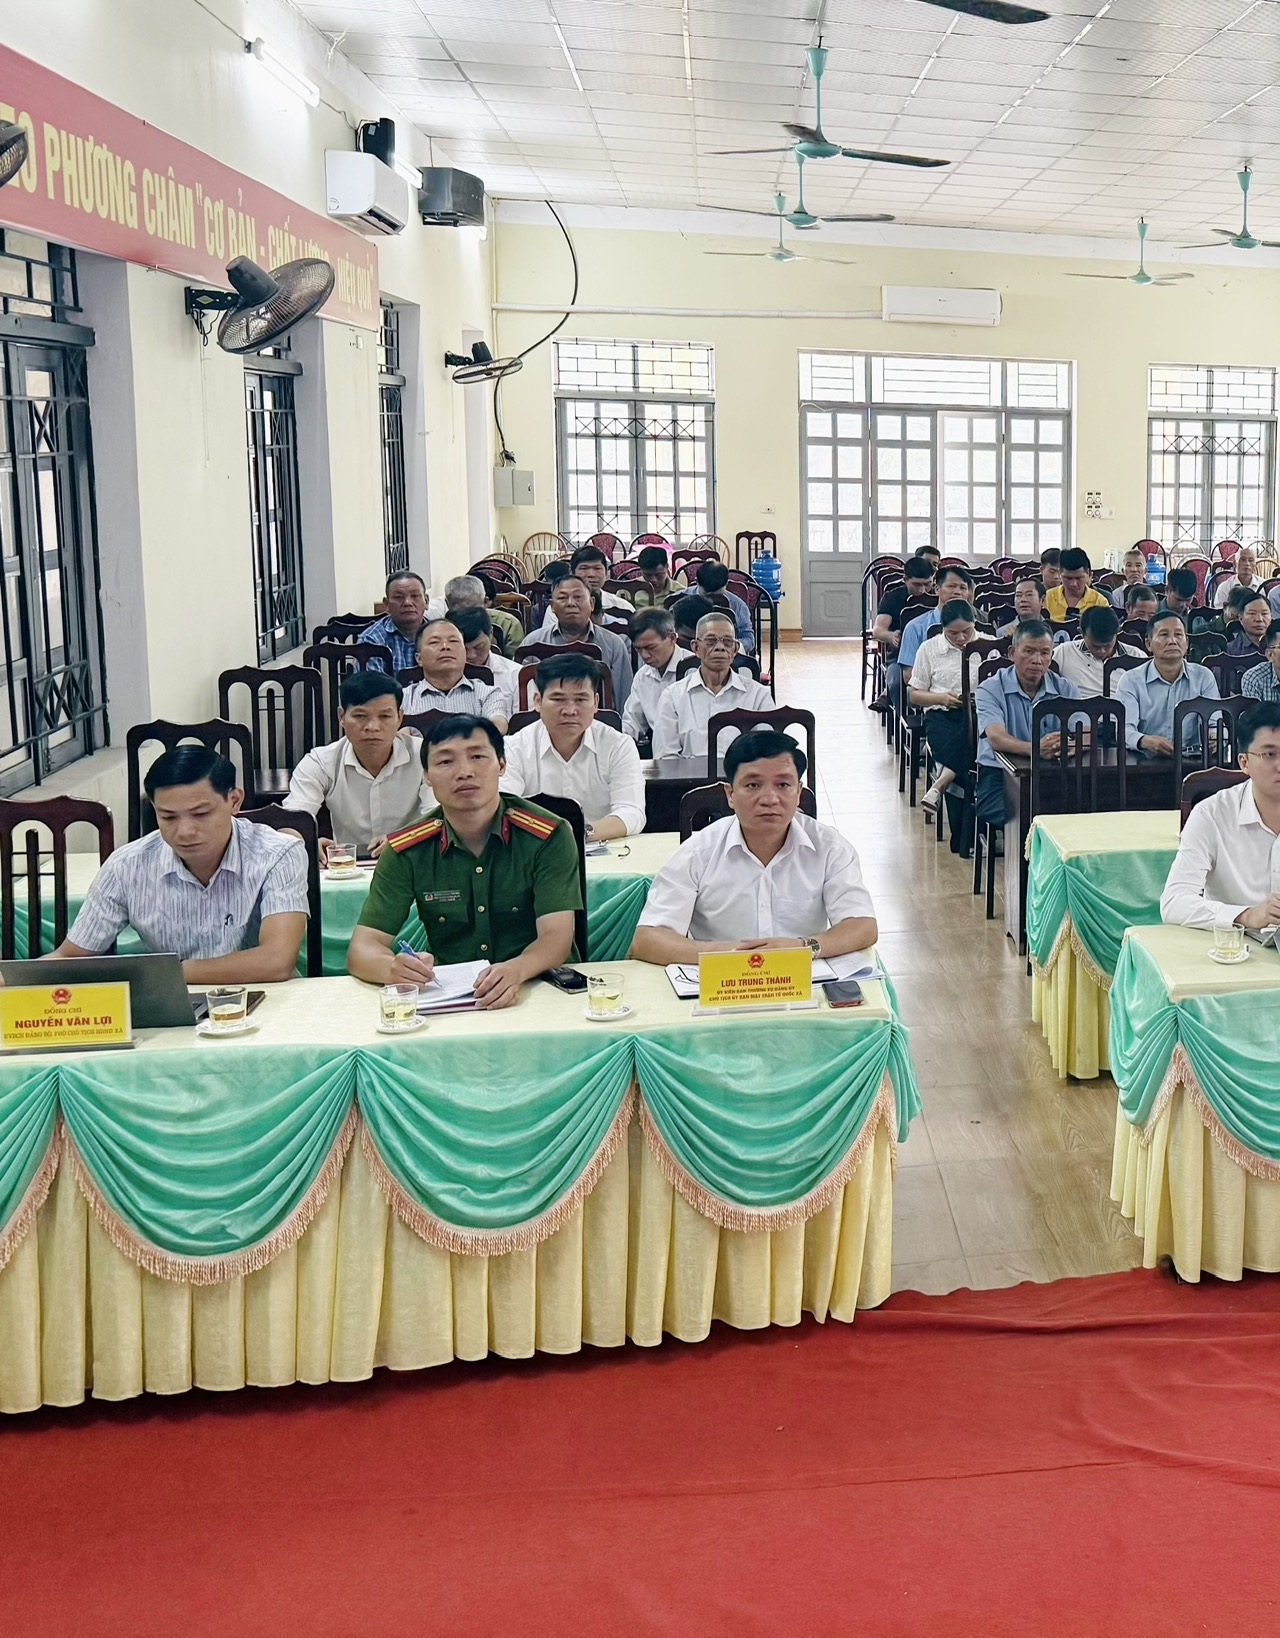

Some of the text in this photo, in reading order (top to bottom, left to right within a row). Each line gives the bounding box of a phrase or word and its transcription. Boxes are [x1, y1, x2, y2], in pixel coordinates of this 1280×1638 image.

[43, 121, 138, 229] PHƯƠNG
[142, 166, 196, 249] CHÂM
[227, 188, 257, 266] BẢN
[337, 252, 356, 313] HIỆU
[738, 978, 764, 986] TRUNG
[15, 1016, 112, 1028] NGUYỄN VĂN LỢI
